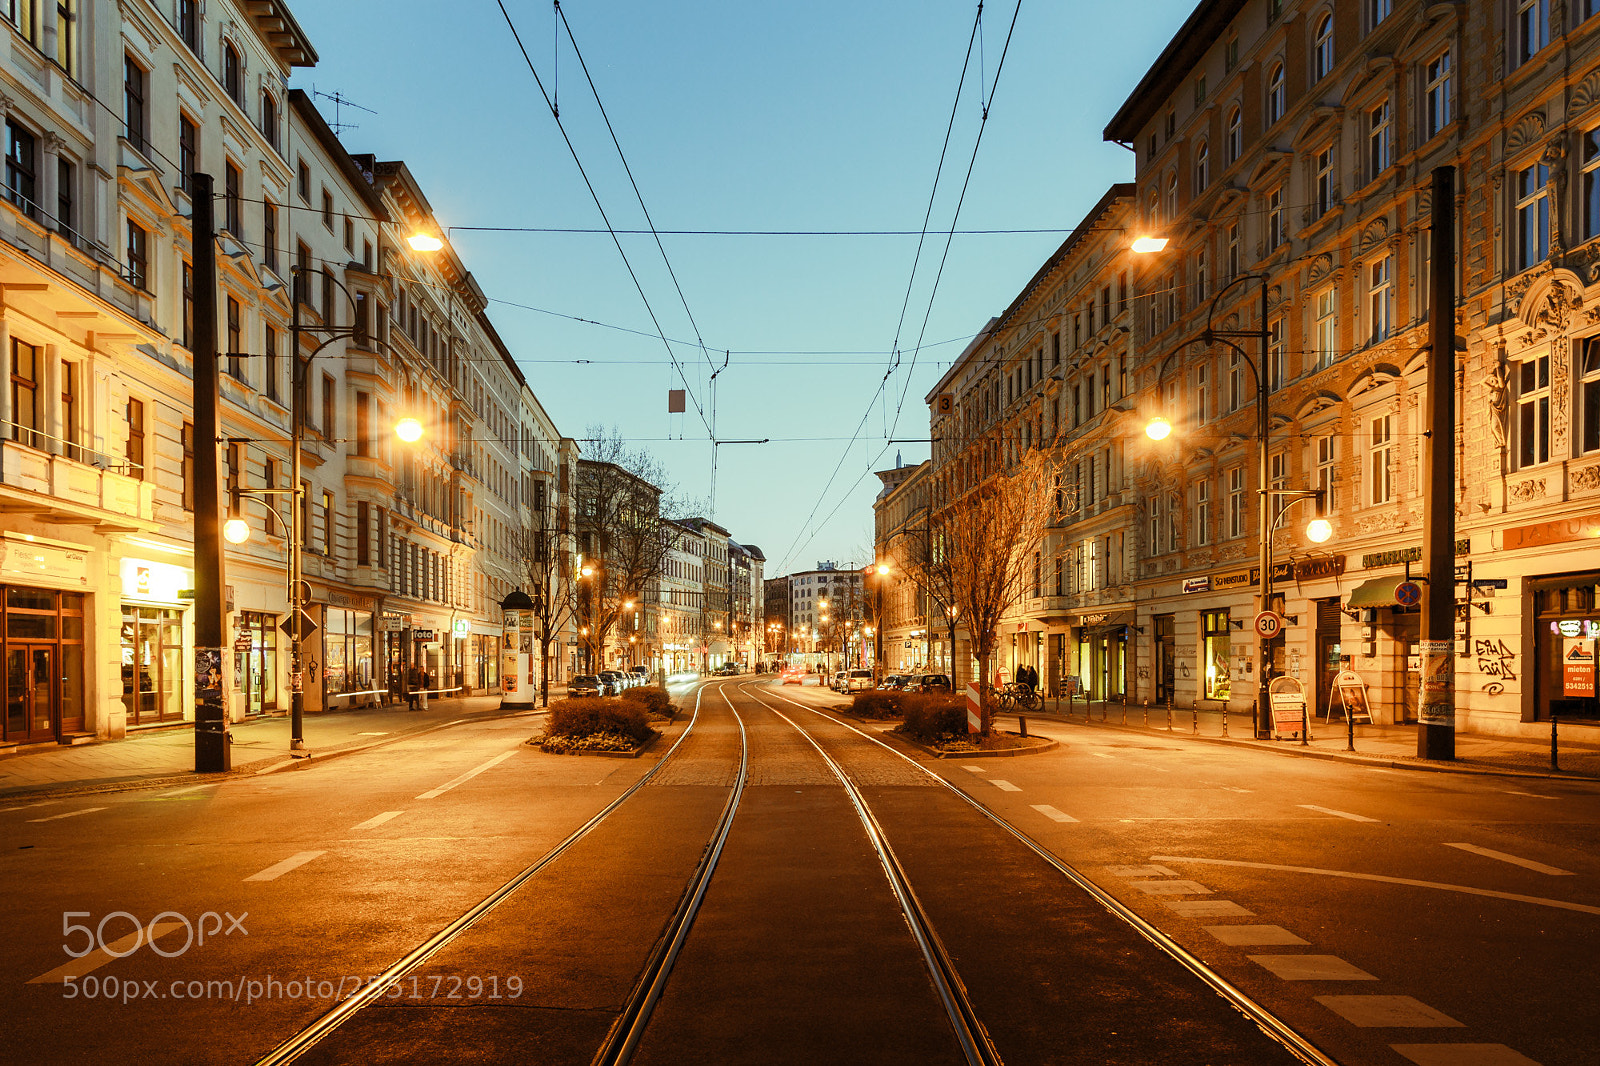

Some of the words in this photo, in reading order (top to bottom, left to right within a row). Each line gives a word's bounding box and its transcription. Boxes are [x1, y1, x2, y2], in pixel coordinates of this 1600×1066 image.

[941, 398, 950, 410] 3
[1517, 515, 1600, 545] JANUS
[1260, 618, 1276, 631] 30
[414, 630, 432, 639] foto
[1567, 665, 1591, 673] mieten
[1565, 682, 1593, 690] 5342513
